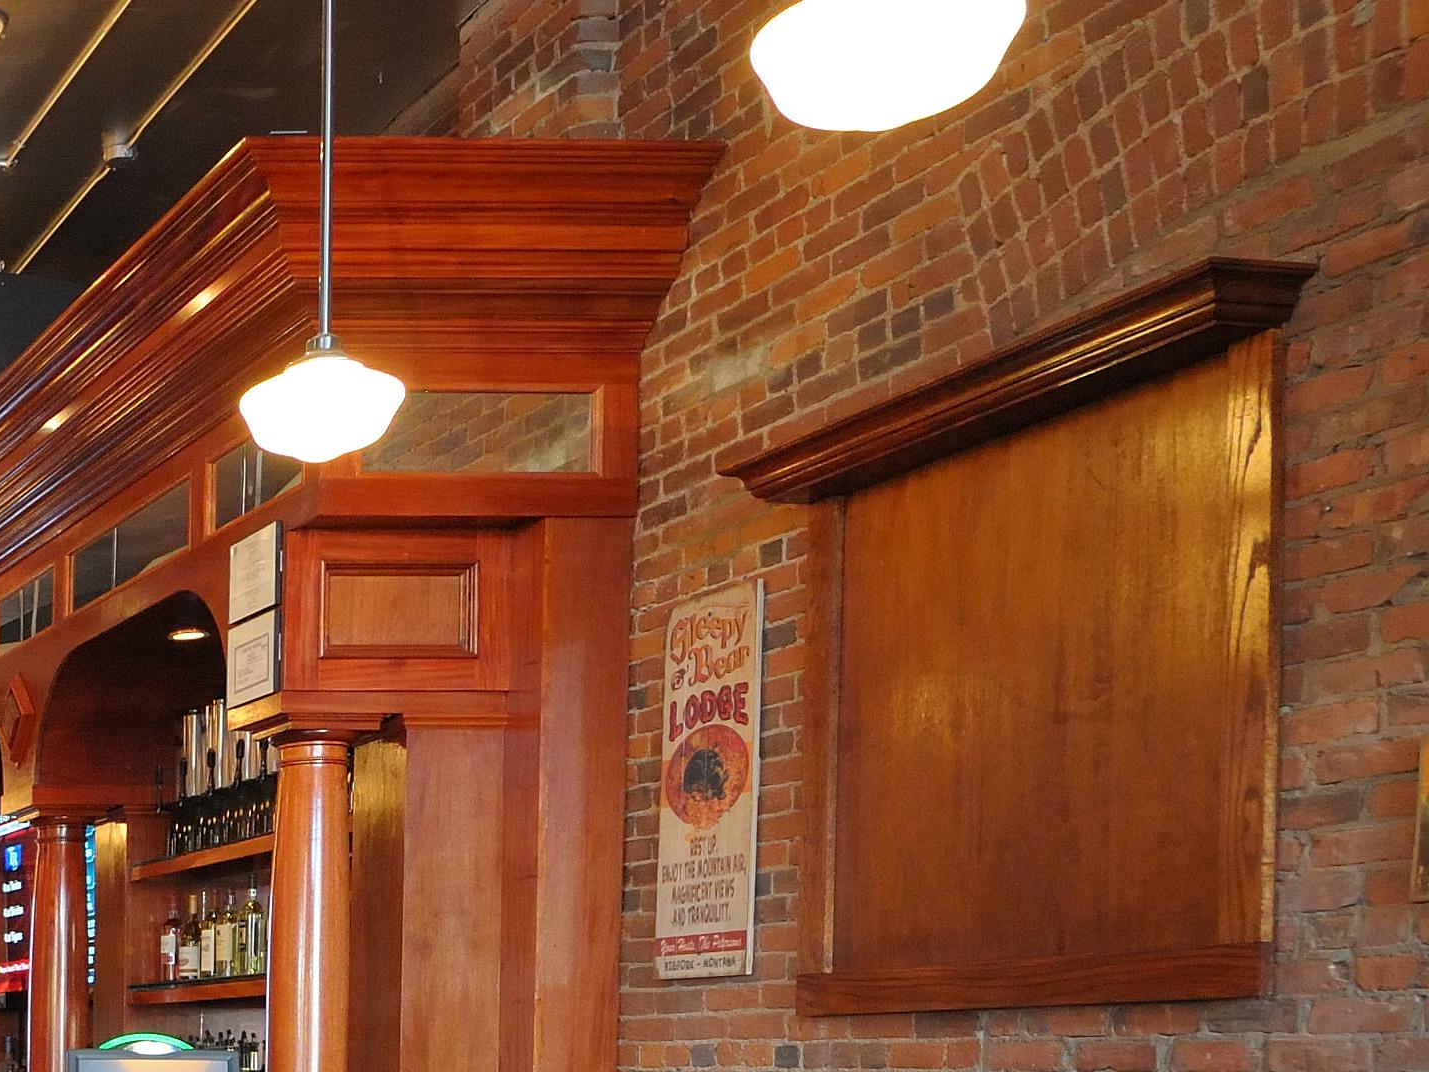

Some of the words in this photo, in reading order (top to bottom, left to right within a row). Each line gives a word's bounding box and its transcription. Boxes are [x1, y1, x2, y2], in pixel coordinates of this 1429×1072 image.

[670, 610, 749, 665] Sleepy
[688, 644, 750, 687] Bear
[669, 682, 749, 742] LODGE
[661, 863, 682, 884] ENJOY
[684, 860, 696, 880] THE
[697, 855, 732, 879] MOUNTAIN
[671, 881, 713, 905] MAGNIFICENT
[715, 878, 736, 899] VIEWS
[671, 906, 686, 928] AND
[702, 956, 736, 969] MONTANA
